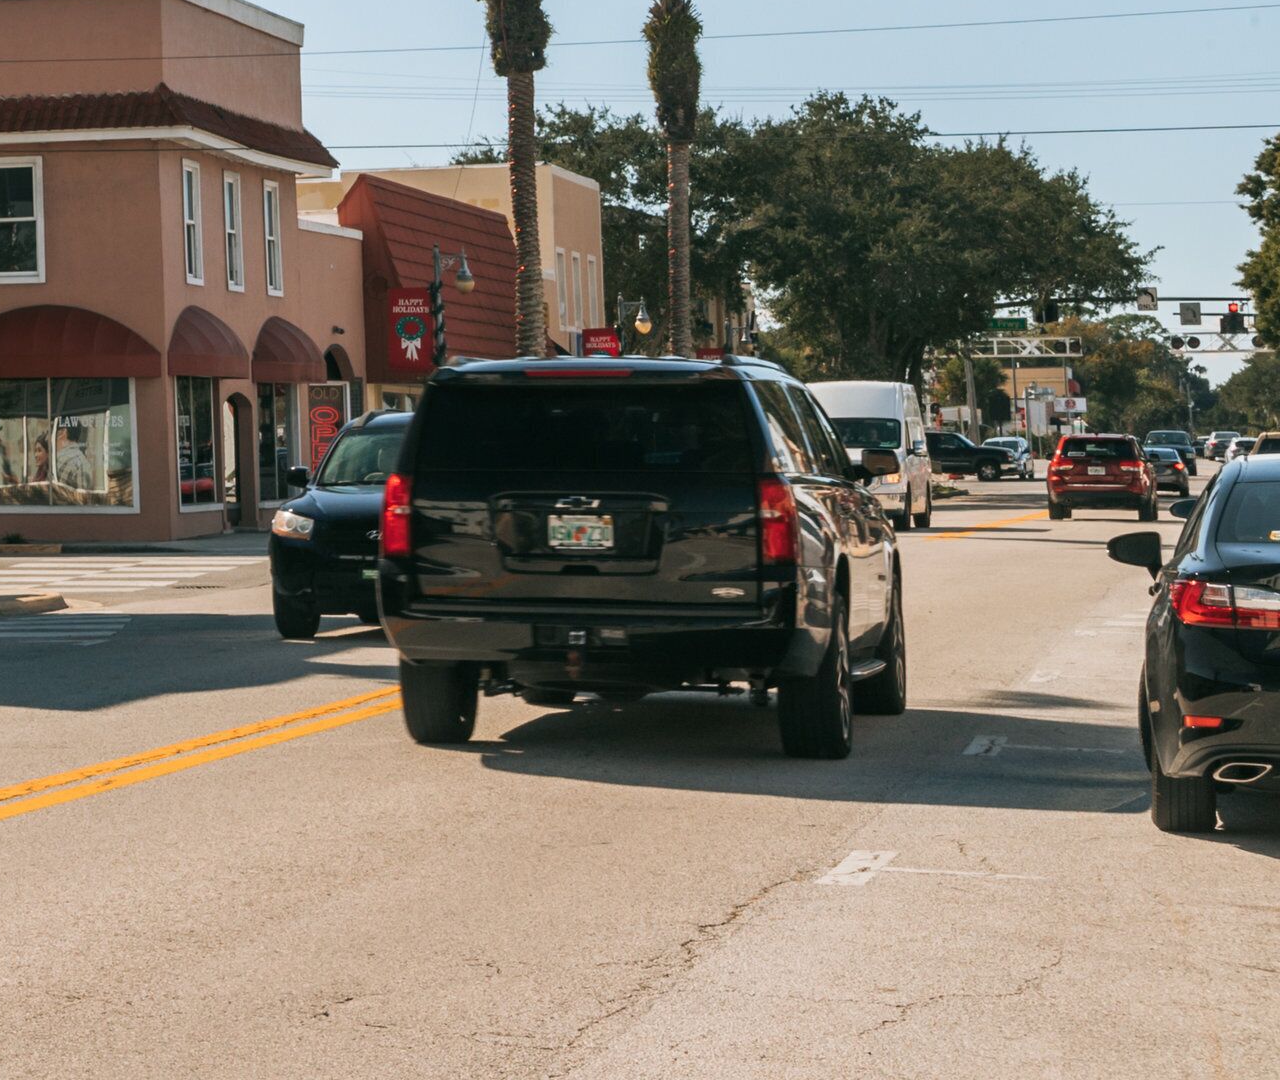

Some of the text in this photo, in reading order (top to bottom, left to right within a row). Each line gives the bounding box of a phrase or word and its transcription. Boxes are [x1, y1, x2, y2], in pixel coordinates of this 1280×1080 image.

[398, 298, 424, 306] HAPPY
[392, 305, 429, 313] HOLIDAYS
[59, 415, 124, 428] LAW OFES
[309, 405, 341, 473] OPE
